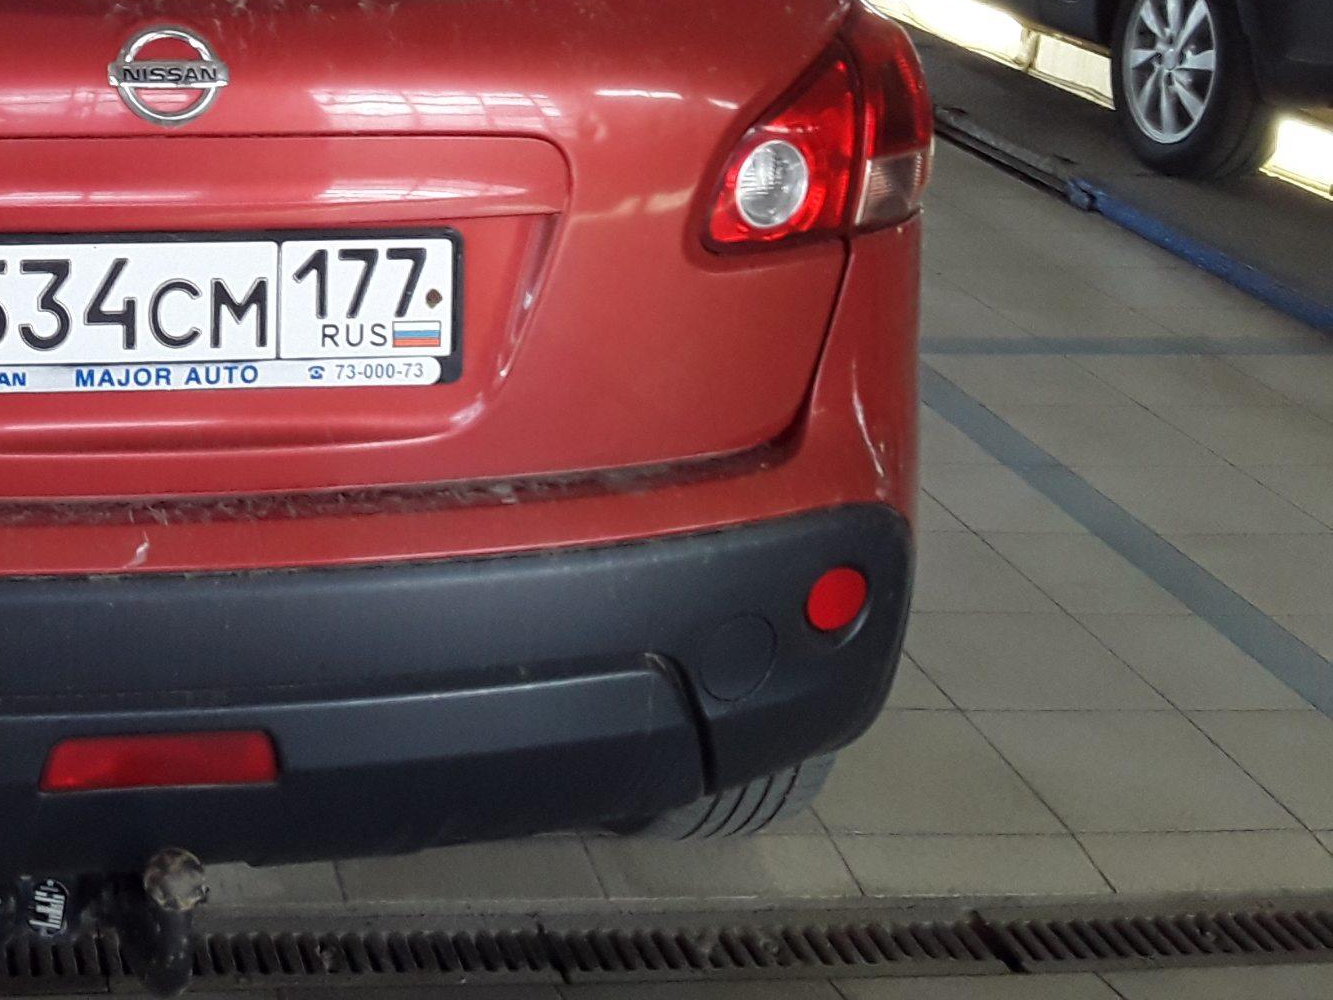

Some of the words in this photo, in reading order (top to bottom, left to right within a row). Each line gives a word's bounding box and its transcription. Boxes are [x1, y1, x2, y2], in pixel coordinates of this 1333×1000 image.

[122, 67, 217, 82] NISSAN
[292, 247, 426, 320] 177
[321, 322, 388, 348] RUS
[75, 367, 172, 388] MAJOR
[184, 364, 259, 385] AUTO
[334, 363, 424, 380] 73-000-73
